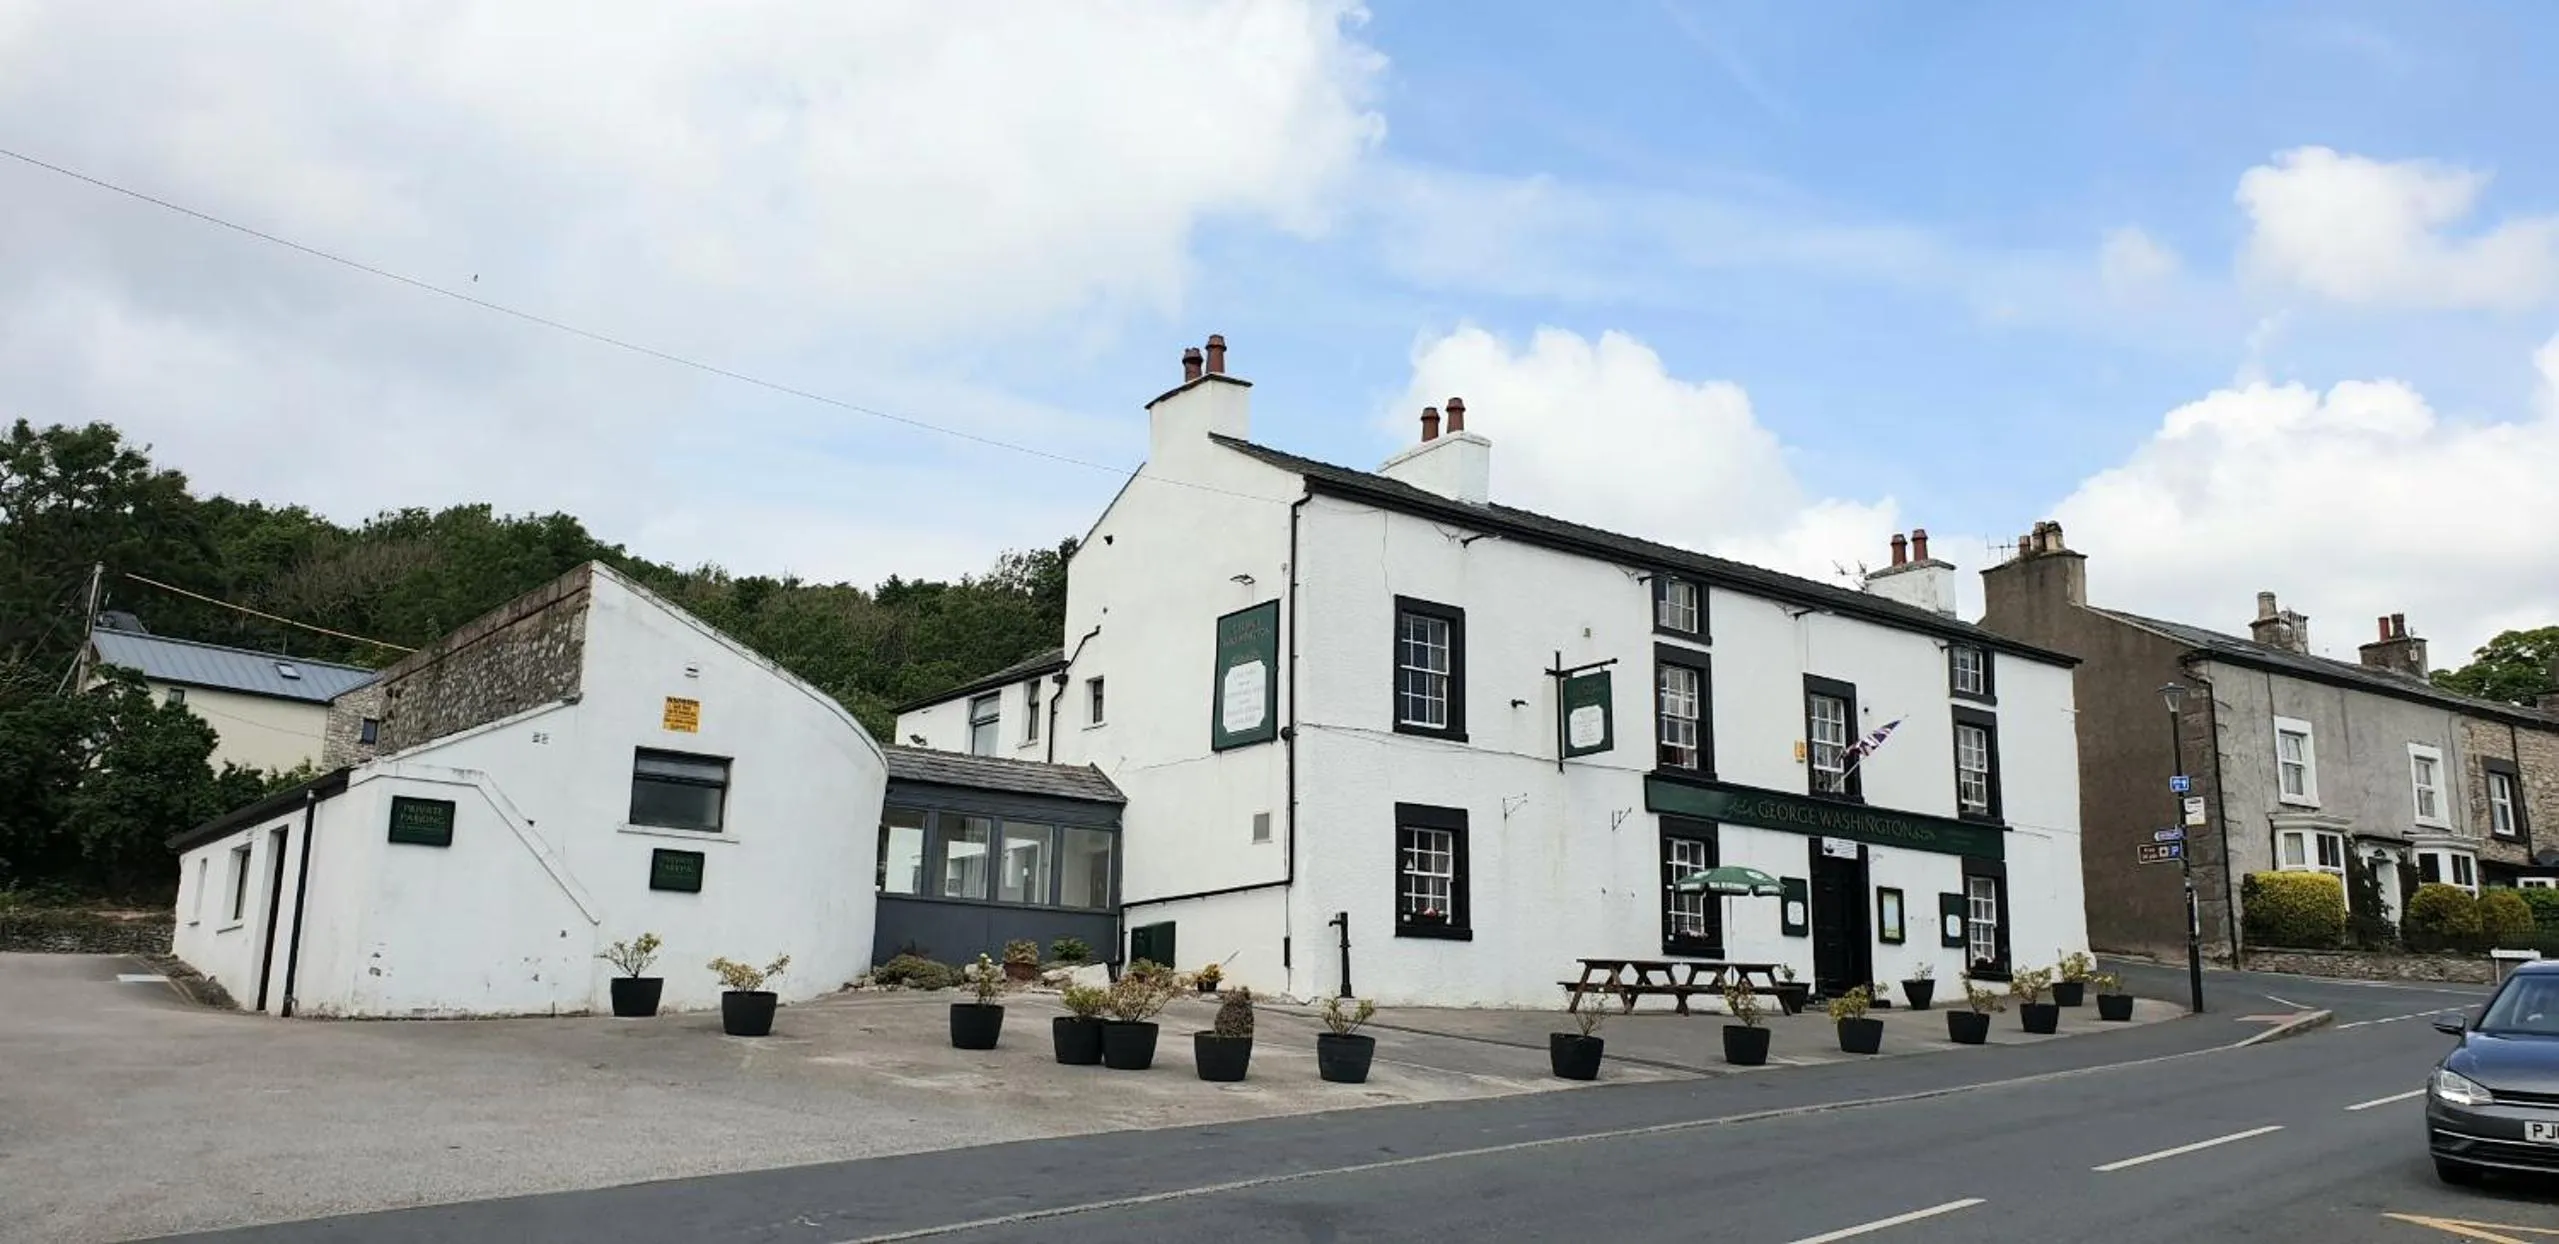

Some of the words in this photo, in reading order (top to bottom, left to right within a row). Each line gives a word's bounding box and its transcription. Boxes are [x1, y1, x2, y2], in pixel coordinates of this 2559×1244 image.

[1758, 800, 1817, 825] GEORGE
[1819, 810, 1913, 838] WASHINGTON
[2532, 1123, 2559, 1140] PJ
